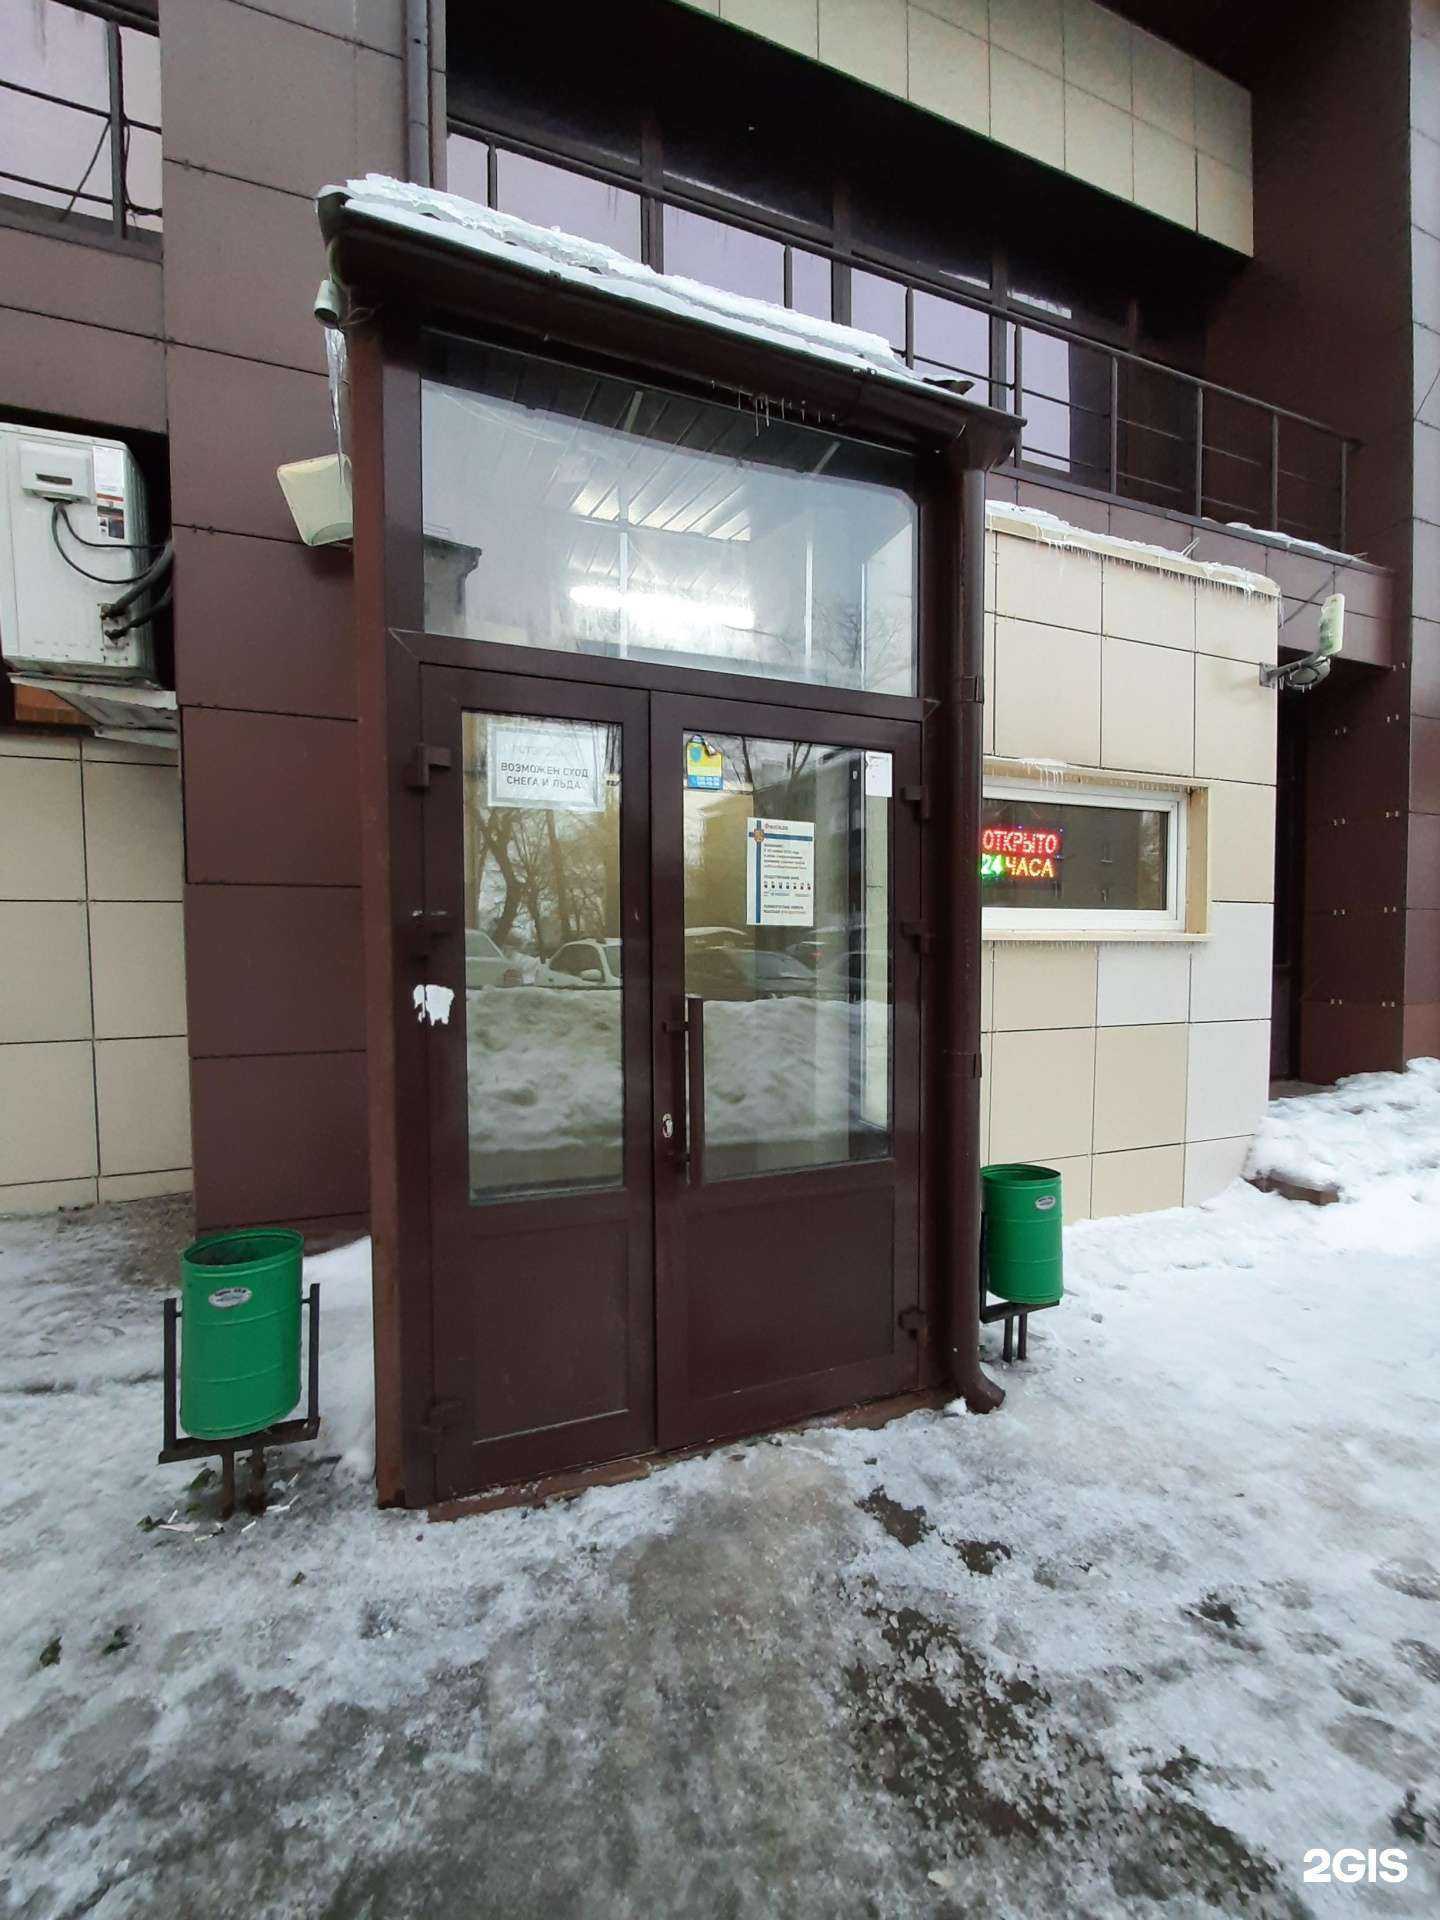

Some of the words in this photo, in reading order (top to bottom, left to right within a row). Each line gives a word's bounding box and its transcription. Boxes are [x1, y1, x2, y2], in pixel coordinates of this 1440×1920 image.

[501, 762, 560, 775] ВОЗМОЖЕН
[563, 768, 589, 778] СХОД
[506, 775, 539, 786] СНЕГА
[542, 779, 549, 787] И
[982, 828, 1057, 853] ОТКРЫТО
[981, 853, 1003, 875] 24
[1005, 856, 1055, 878] ЧАСА
